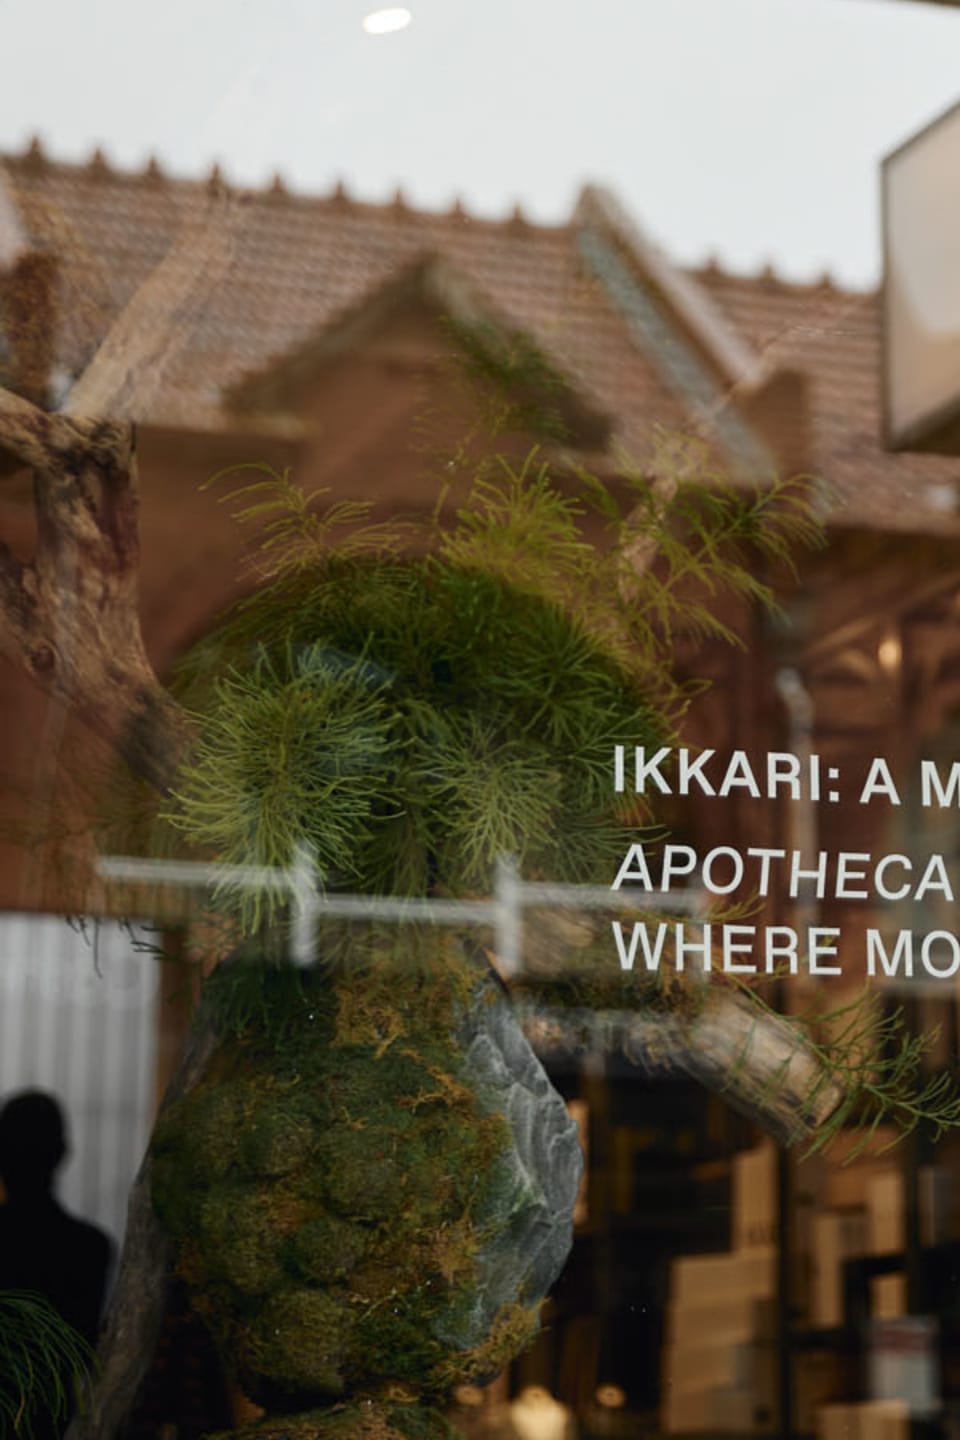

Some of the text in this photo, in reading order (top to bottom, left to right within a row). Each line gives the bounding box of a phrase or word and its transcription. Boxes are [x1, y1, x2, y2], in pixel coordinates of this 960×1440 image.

[612, 744, 840, 803] IKKARI:
[859, 757, 902, 806] A
[611, 920, 843, 976] WHERE
